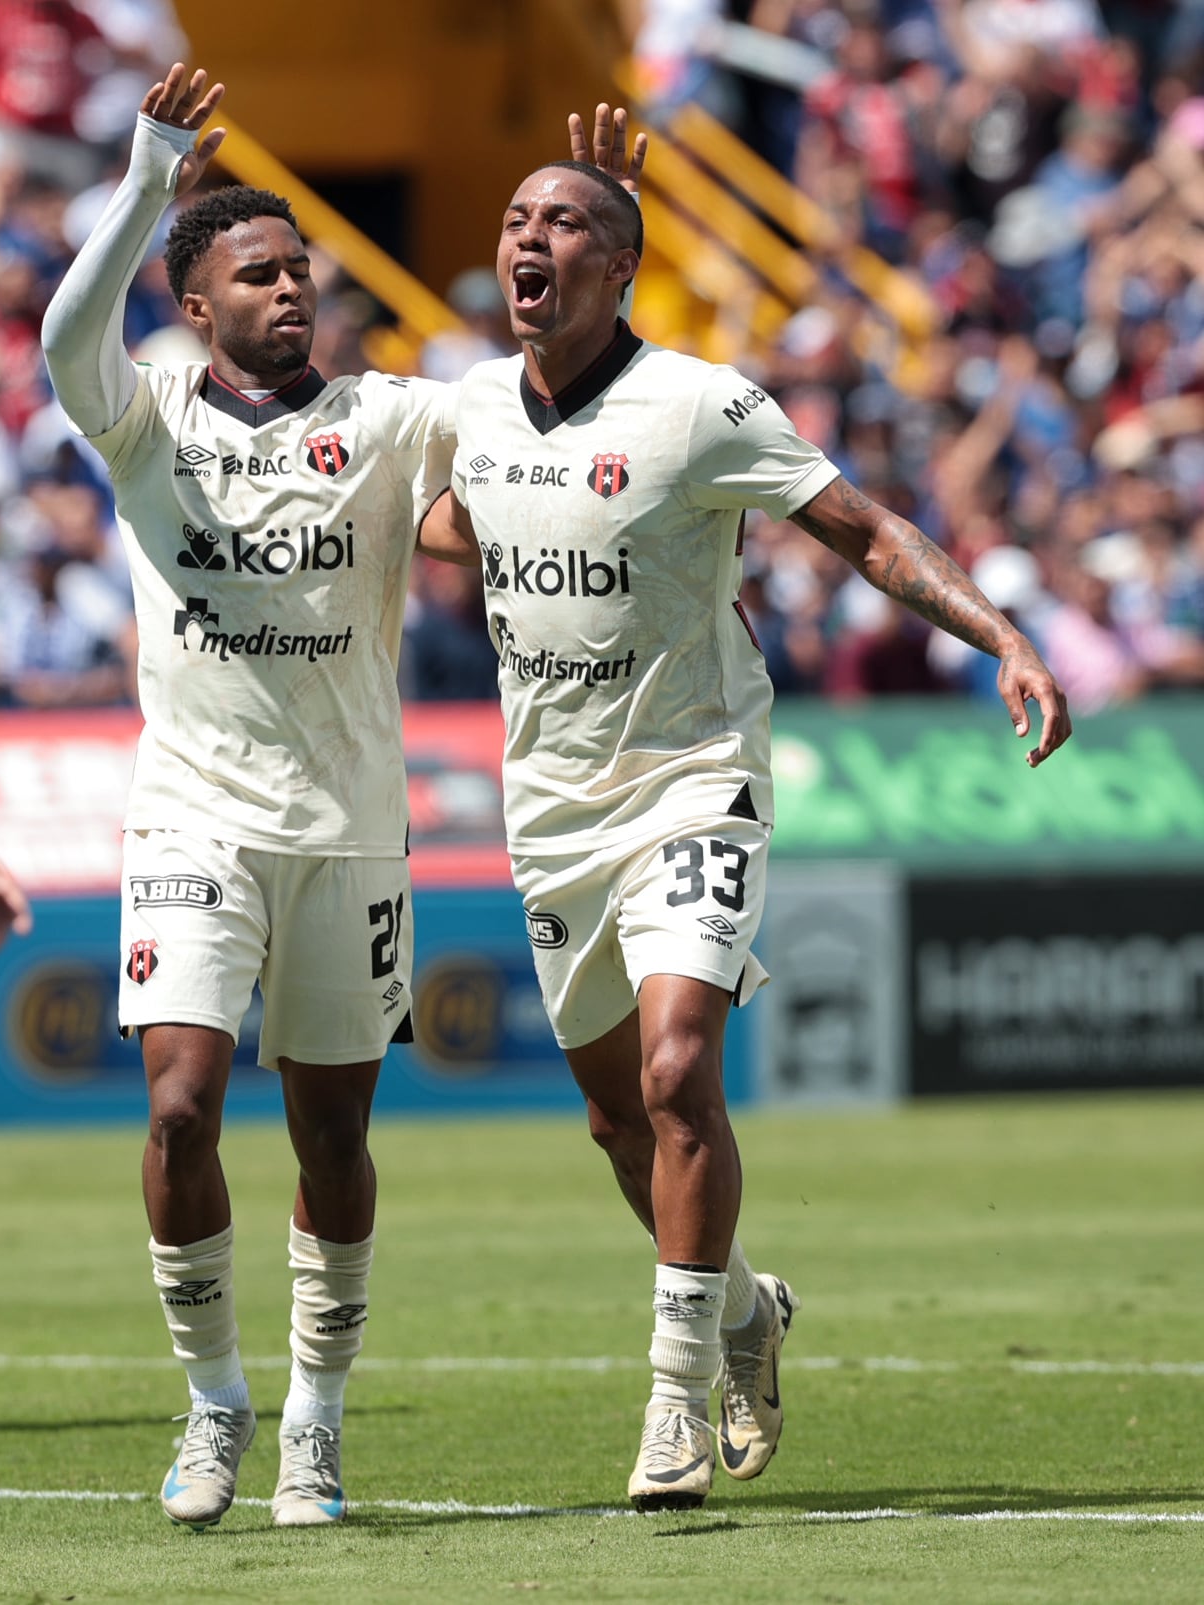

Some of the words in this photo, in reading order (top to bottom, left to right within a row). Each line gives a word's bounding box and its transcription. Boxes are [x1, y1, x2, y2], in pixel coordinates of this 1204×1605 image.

[311, 437, 338, 447] LDA
[247, 455, 292, 476] BAC
[597, 456, 622, 465] LDA
[174, 466, 211, 478] umbro
[530, 465, 570, 487] BAC
[232, 520, 354, 575] kölbi
[512, 546, 630, 597] kölbi
[200, 624, 352, 662] medismart
[508, 649, 636, 687] medismart
[663, 839, 749, 912] 33
[132, 881, 209, 903] ABUS
[700, 931, 733, 950] umbro
[165, 1290, 223, 1306] umbro
